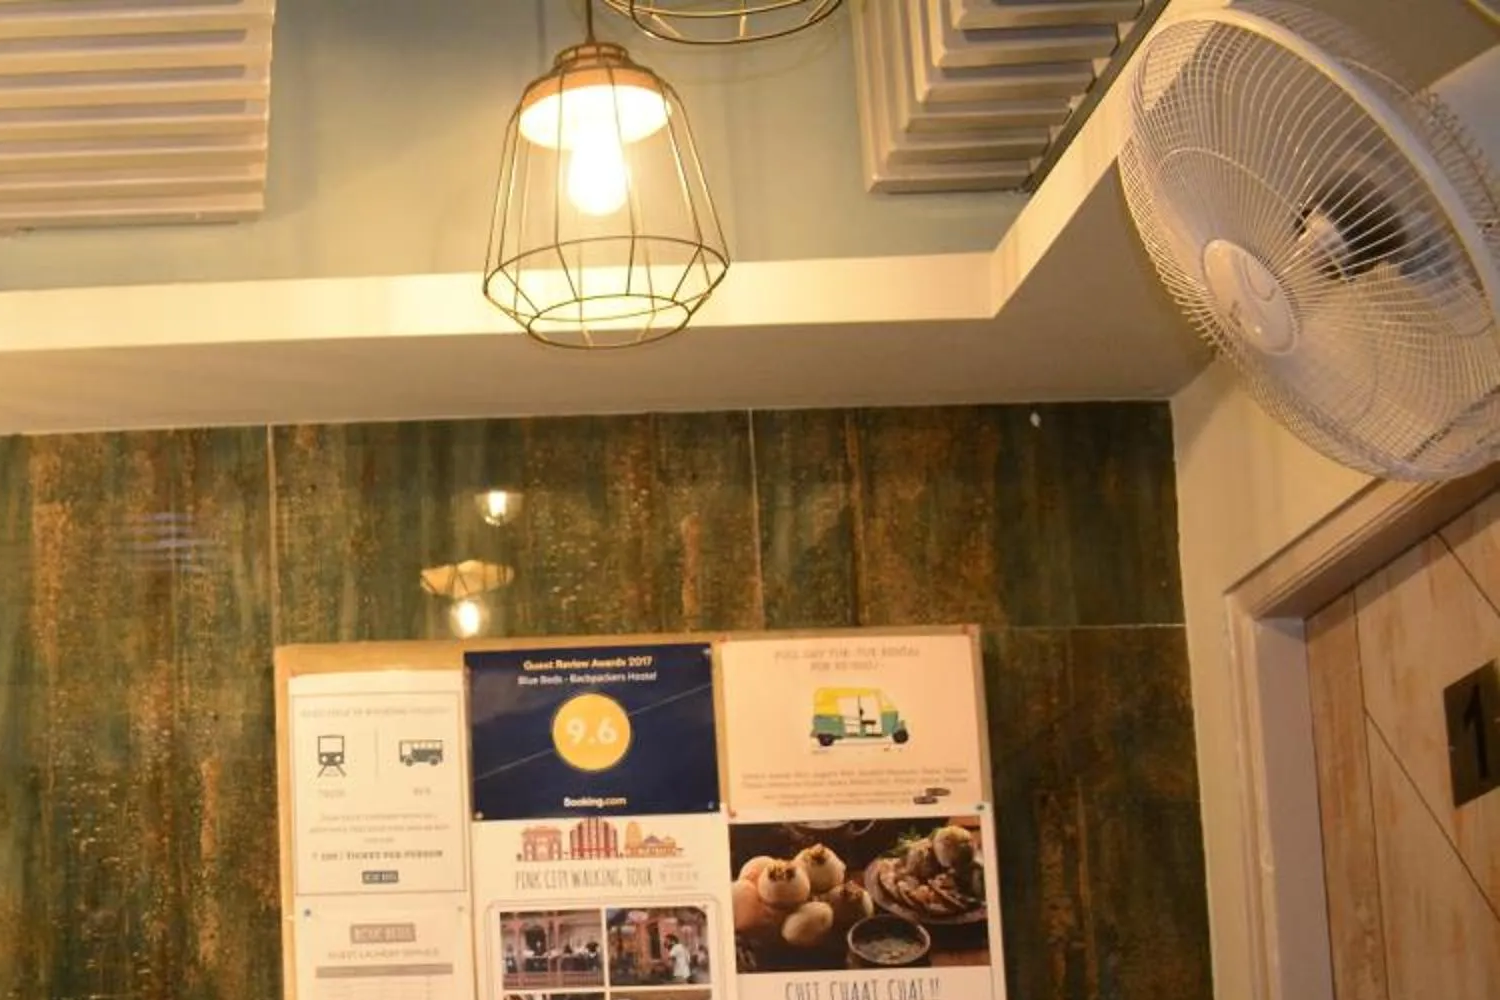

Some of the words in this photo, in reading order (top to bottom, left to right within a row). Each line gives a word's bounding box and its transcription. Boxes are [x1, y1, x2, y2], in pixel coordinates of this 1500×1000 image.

[523, 660, 554, 671] Guest
[555, 659, 589, 670] Review
[592, 658, 626, 669] Awards
[628, 656, 653, 667] 2017
[518, 675, 538, 685] Blue
[540, 675, 563, 685] Beds
[569, 673, 626, 684] Backpackers
[627, 672, 656, 682] Hostel
[566, 717, 617, 744] 9.6
[563, 796, 627, 808] Booking.com
